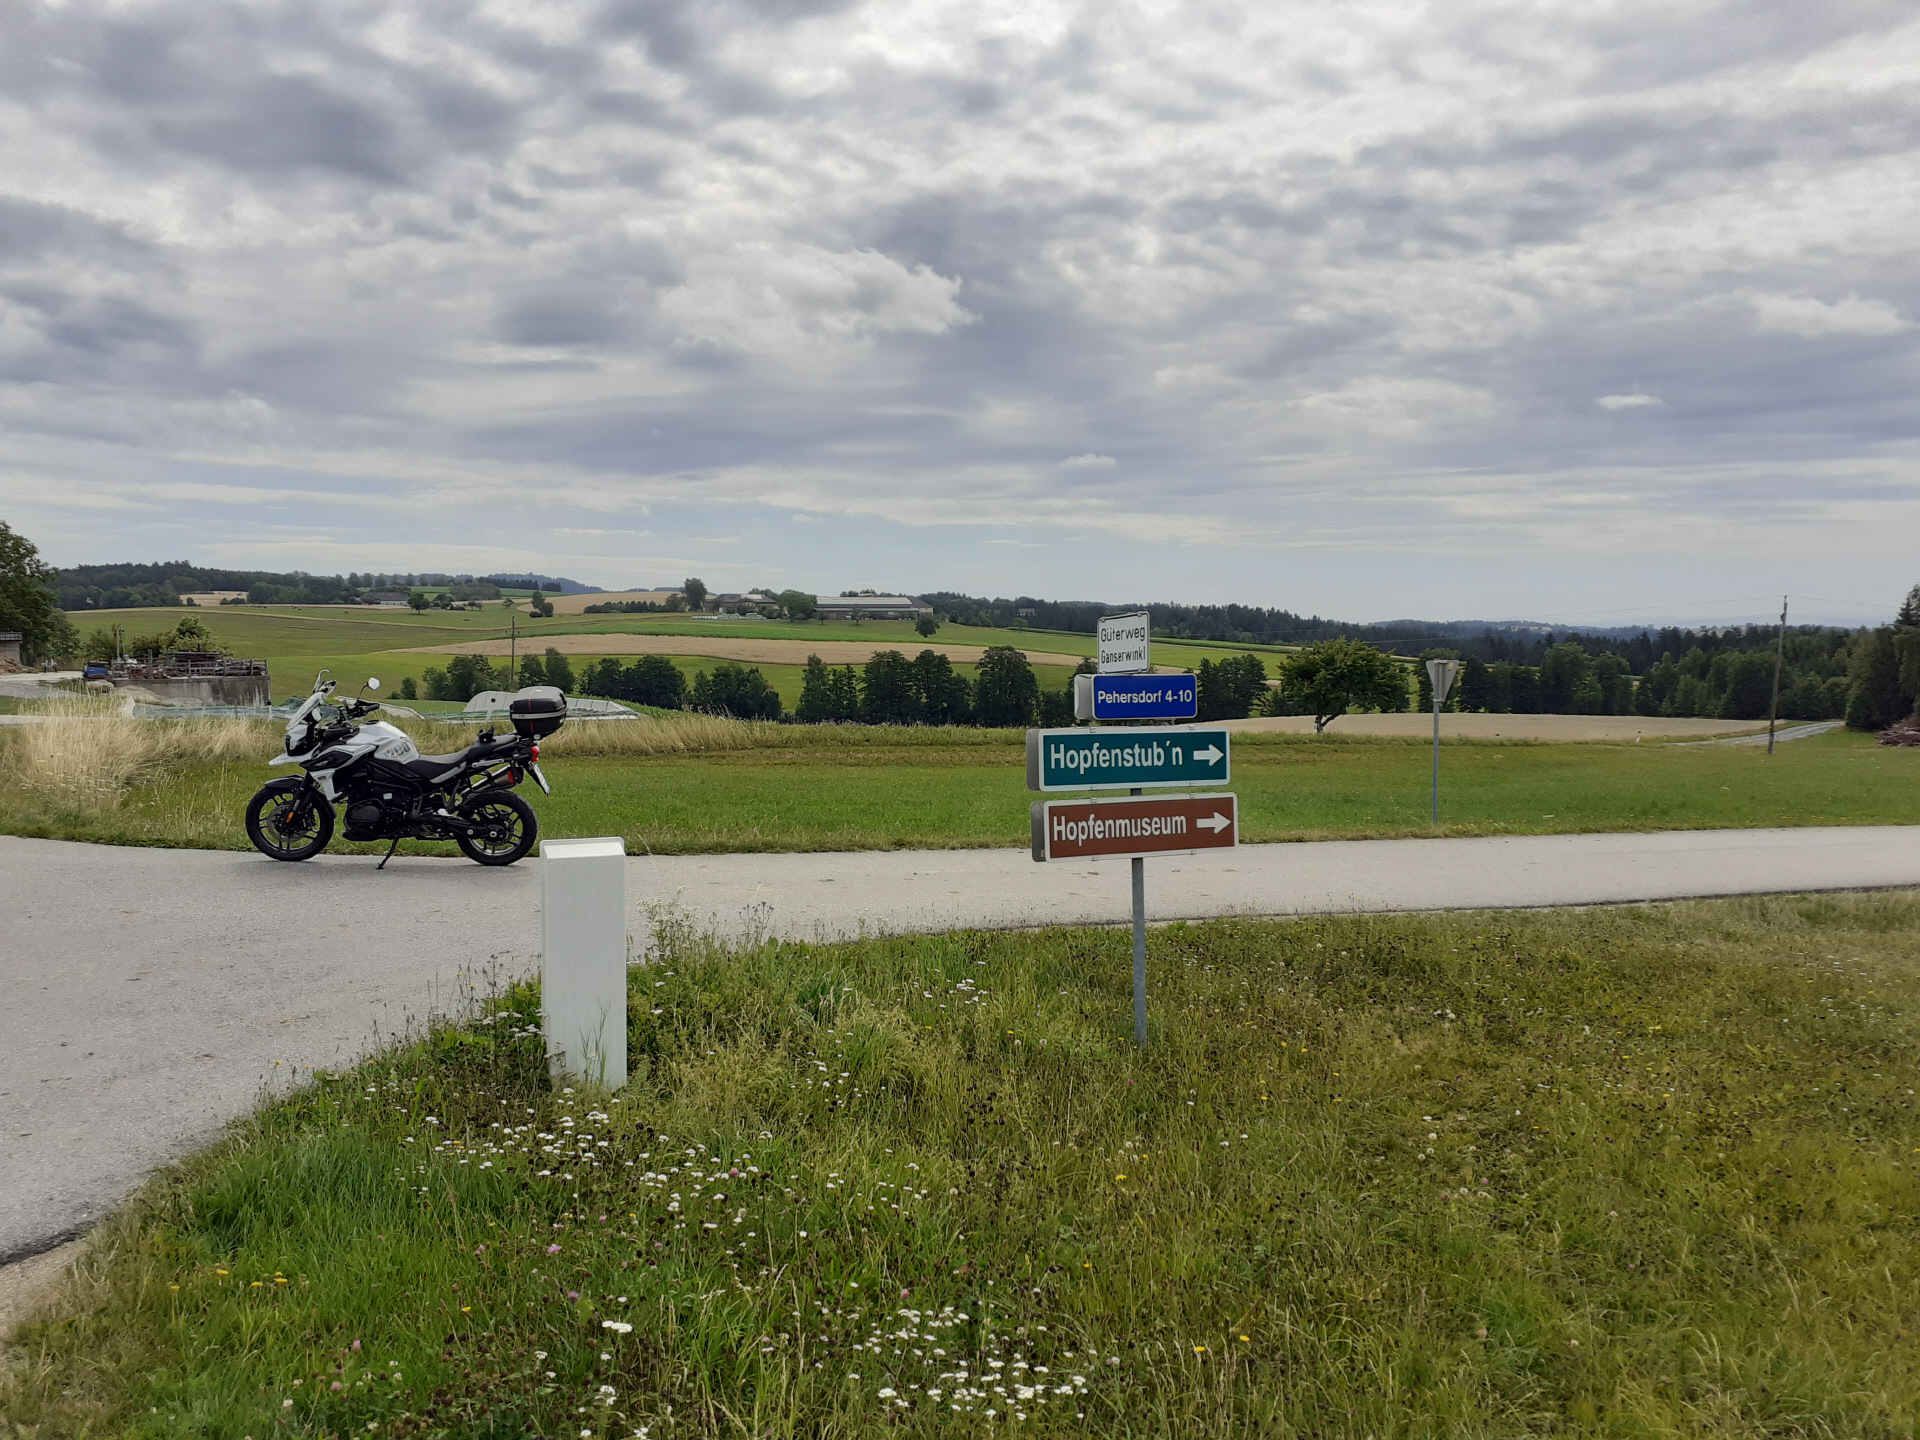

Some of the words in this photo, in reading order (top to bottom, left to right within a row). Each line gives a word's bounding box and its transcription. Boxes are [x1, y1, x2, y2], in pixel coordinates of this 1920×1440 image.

[1100, 626, 1146, 642] Güterweg
[1101, 645, 1146, 664] Ganserwinkl
[1097, 690, 1162, 704] Pehersdorf
[1165, 689, 1193, 703] 4-10
[1053, 813, 1187, 847] Hopfenmuseum
